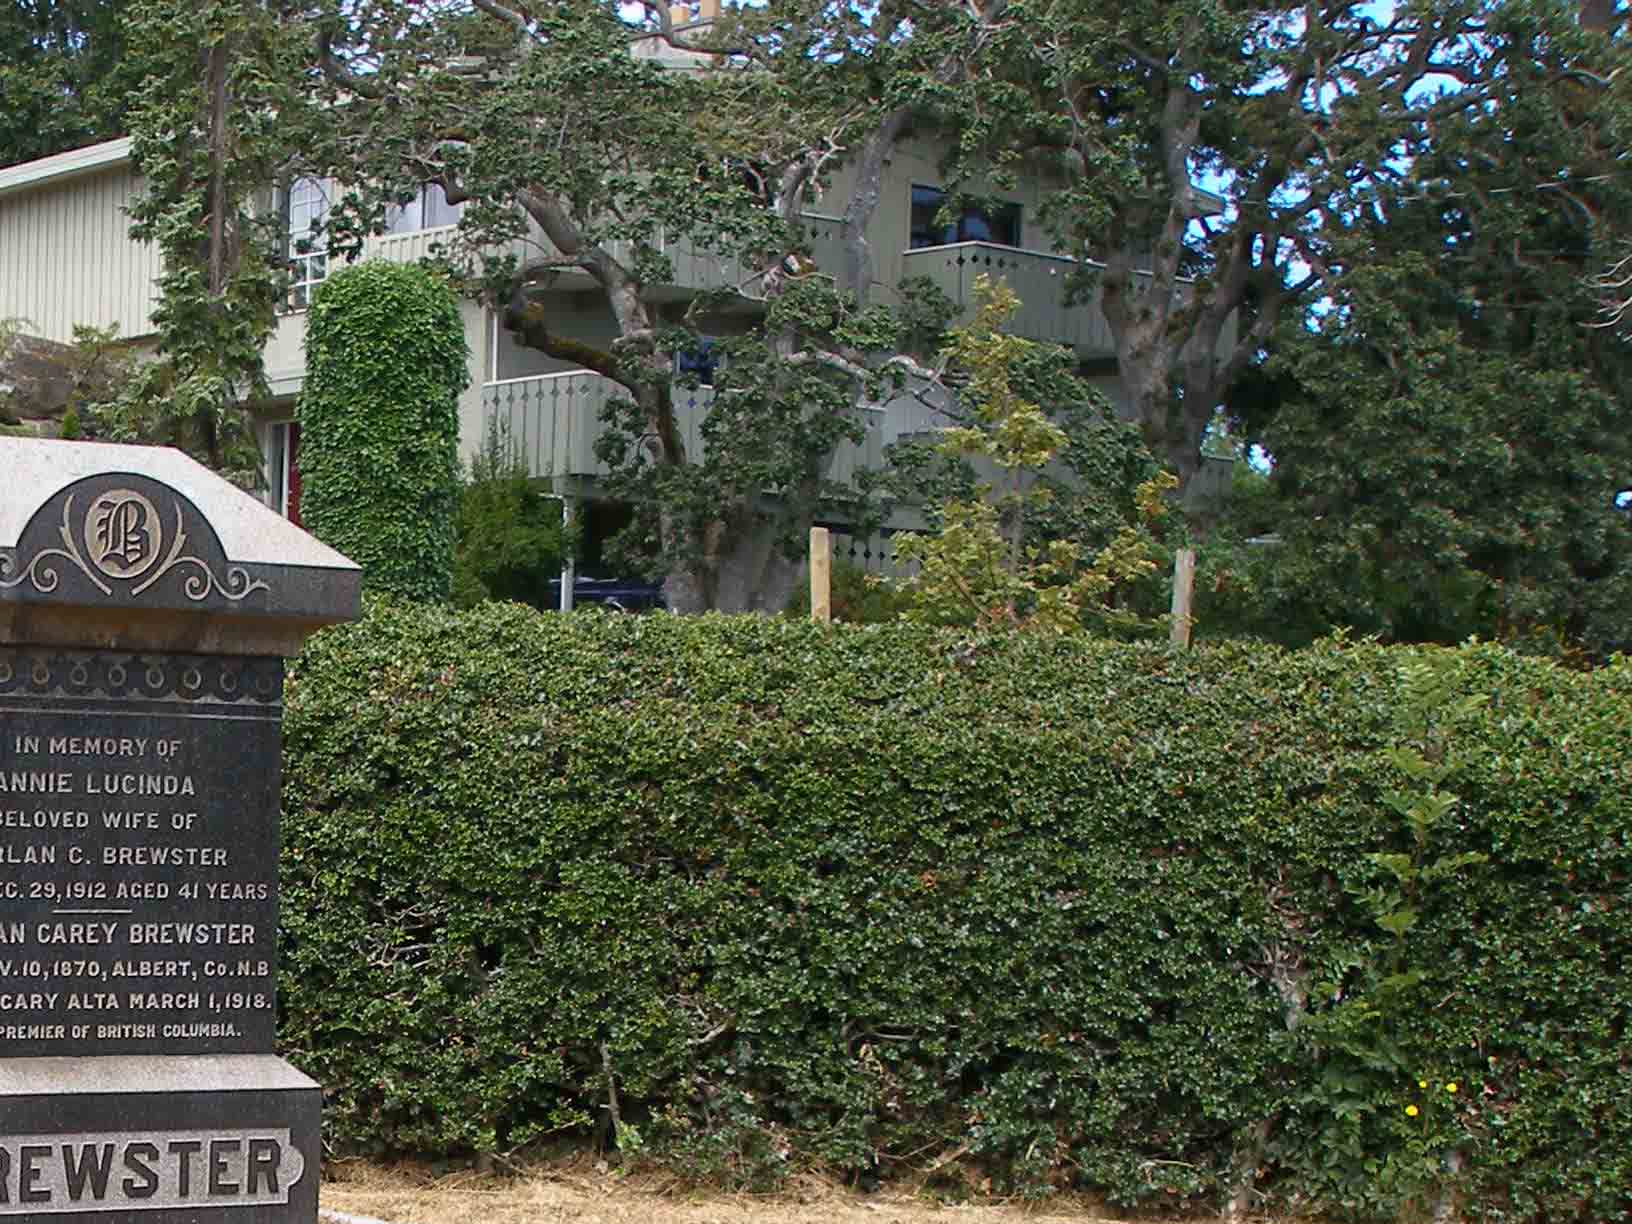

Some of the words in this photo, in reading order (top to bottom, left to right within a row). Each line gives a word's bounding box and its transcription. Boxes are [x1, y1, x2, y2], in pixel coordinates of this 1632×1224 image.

[15, 736, 39, 754] IN
[49, 737, 146, 756] MEMORY
[157, 739, 182, 757] OF
[86, 774, 196, 796] LUCINDA
[102, 812, 159, 830] WIFE
[171, 813, 197, 831] OF
[68, 847, 91, 867] C.
[103, 848, 228, 867] BREWSTER
[116, 882, 169, 900] AGED
[178, 882, 199, 899] 41
[208, 883, 269, 901] YEARS
[37, 922, 118, 945] CAREY
[129, 923, 256, 946] BREWSTER
[68, 992, 119, 1010] ALTA
[129, 992, 199, 1010] MARCH
[71, 1023, 90, 1039] OF
[96, 1023, 156, 1039] BRITISH
